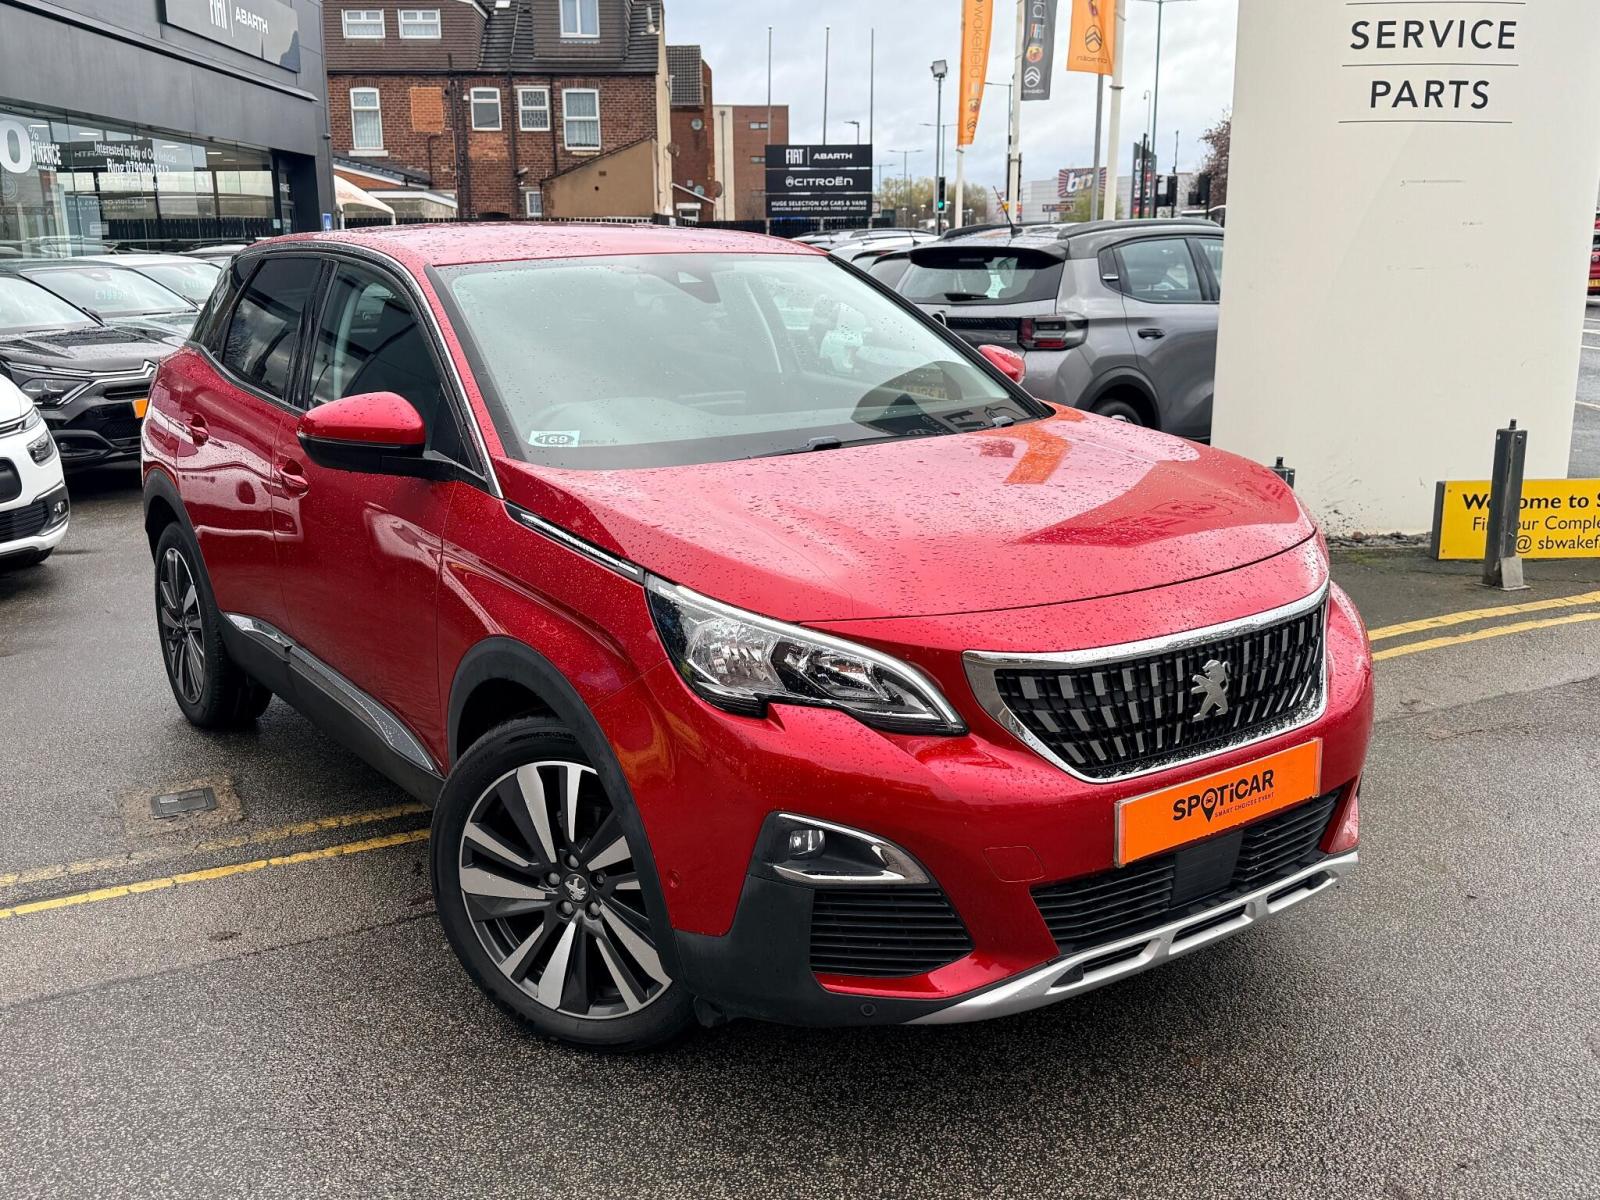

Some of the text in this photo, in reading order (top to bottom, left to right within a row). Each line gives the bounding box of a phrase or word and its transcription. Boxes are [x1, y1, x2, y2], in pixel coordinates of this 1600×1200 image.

[236, 6, 269, 34] ABARTH
[1350, 20, 1517, 50] SERVICE
[1370, 80, 1490, 109] PARTS
[95, 140, 123, 156] Interested
[786, 149, 804, 164] FIAT
[539, 435, 568, 444] 169
[1462, 493, 1561, 510] Wome
[1568, 494, 1589, 508] to
[1516, 535, 1532, 553] @
[1214, 792, 1274, 817] SMART CHOICES EVENT
